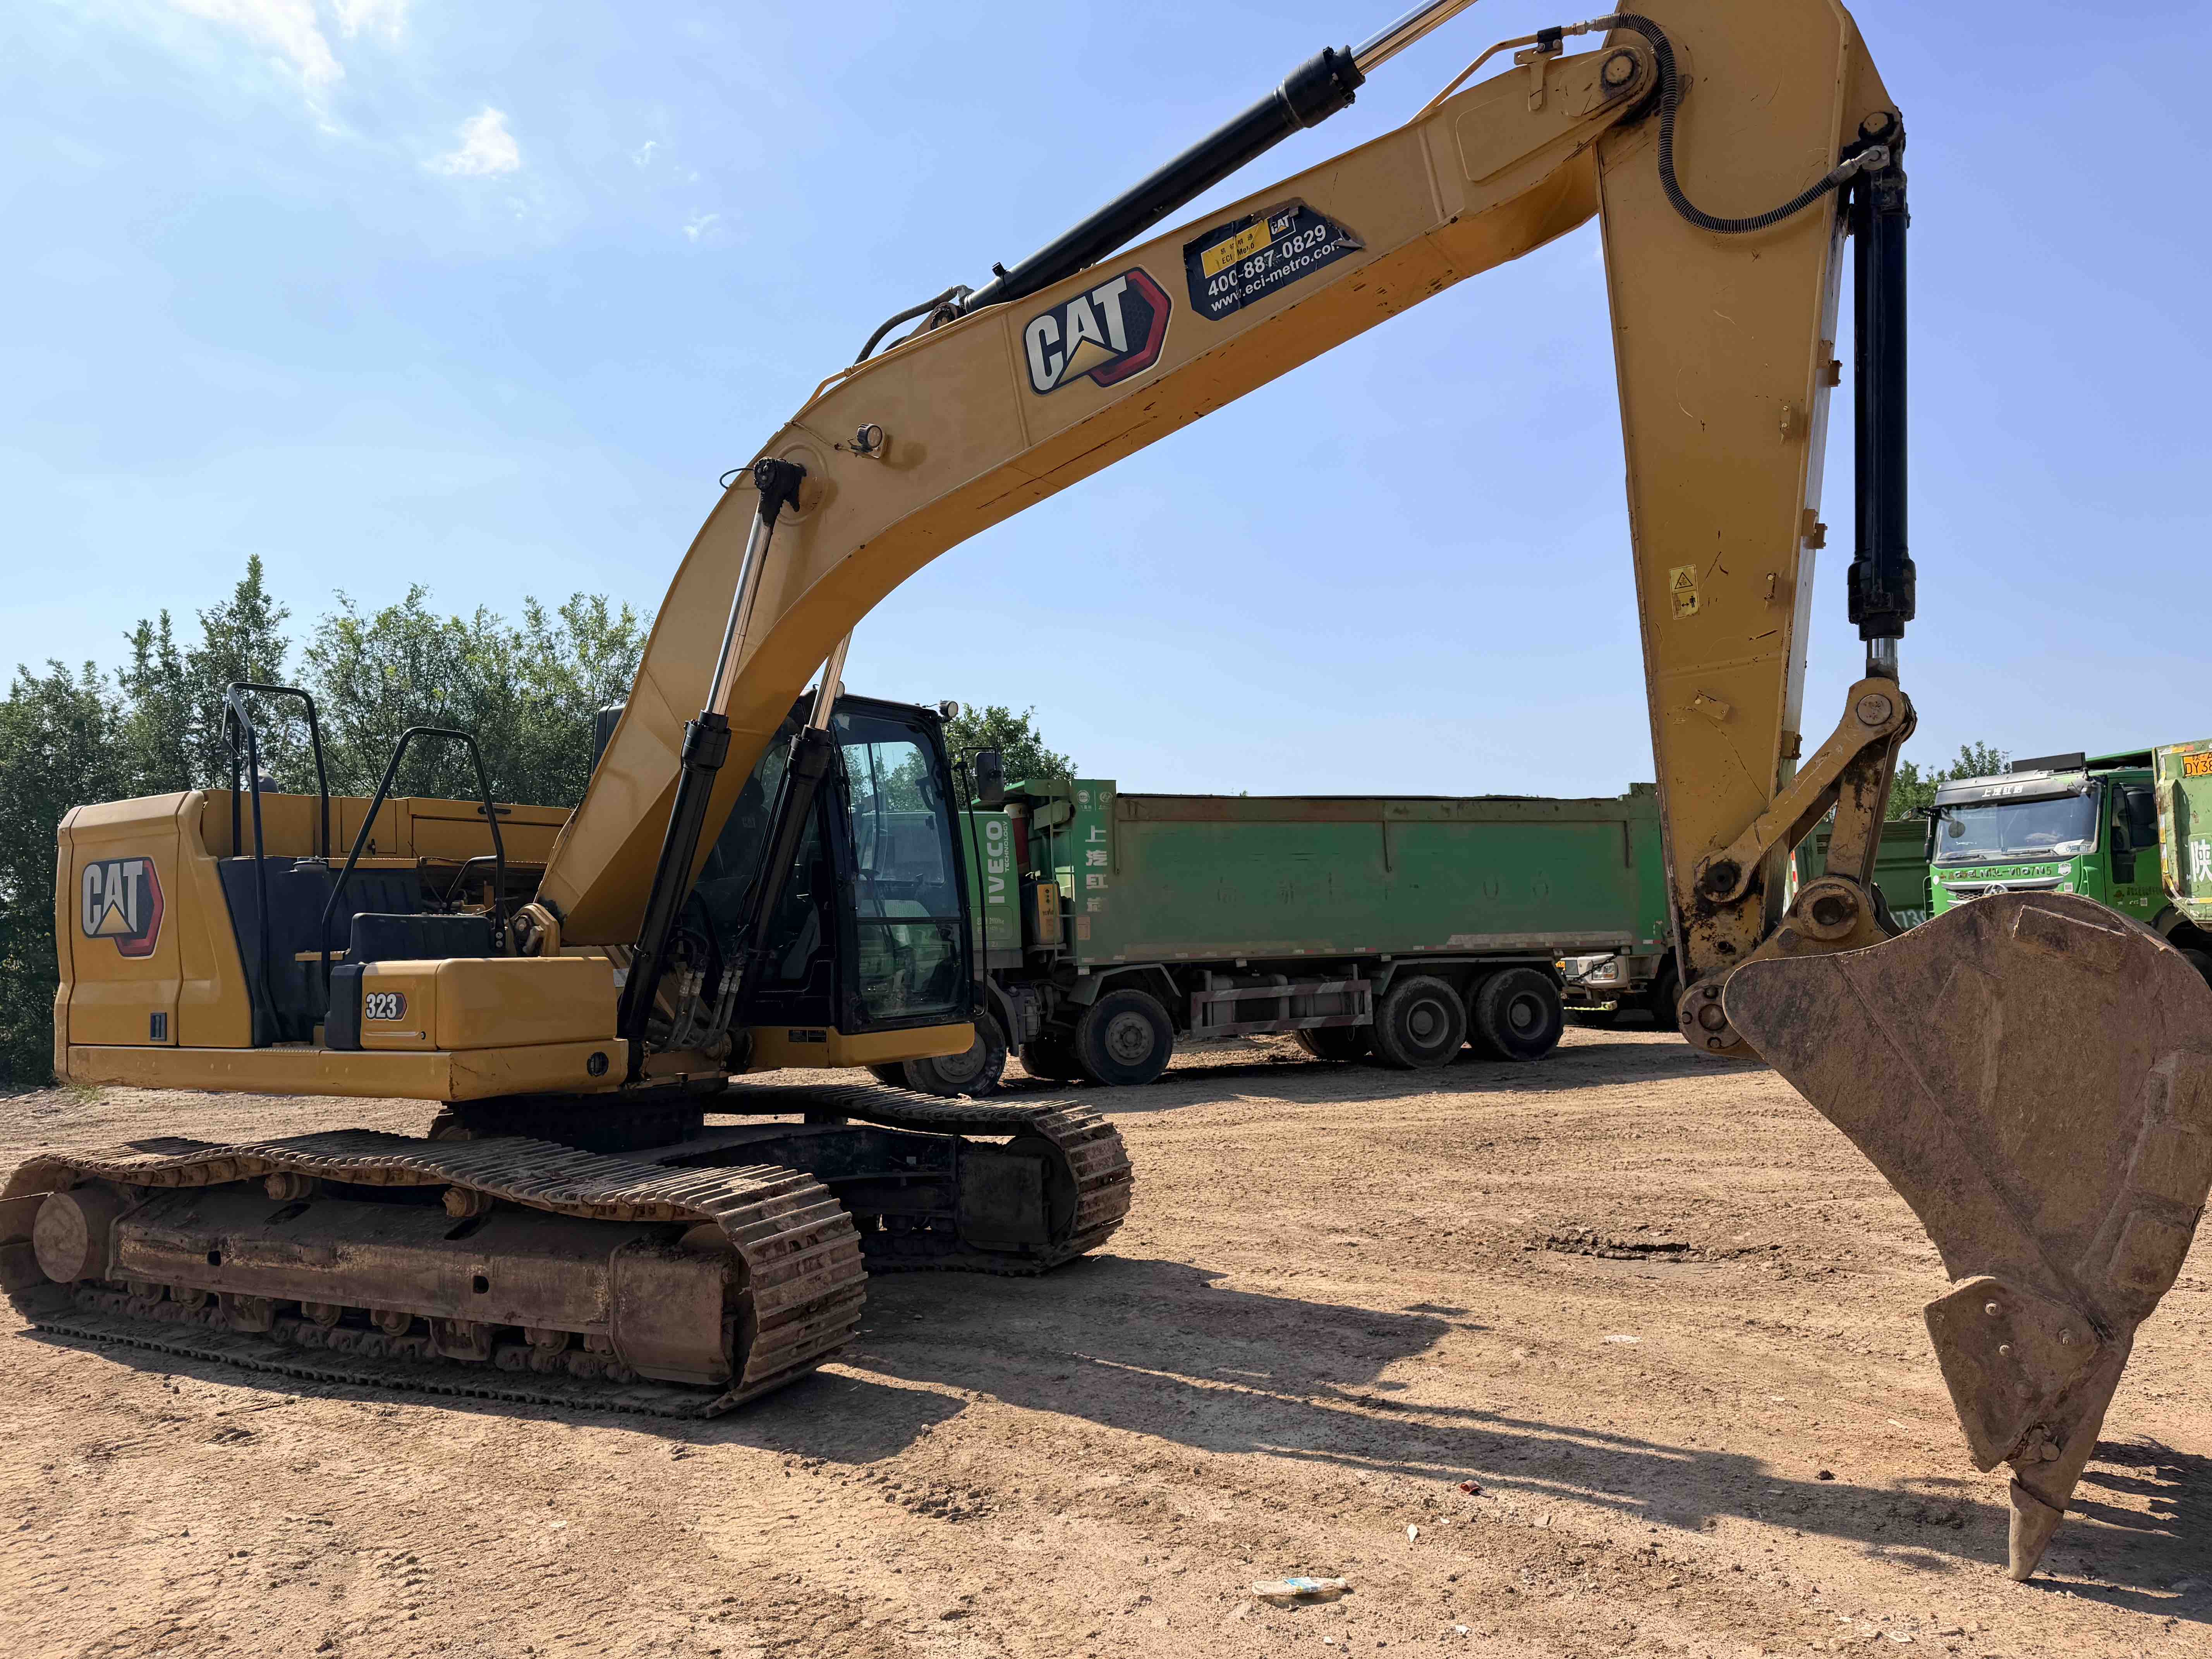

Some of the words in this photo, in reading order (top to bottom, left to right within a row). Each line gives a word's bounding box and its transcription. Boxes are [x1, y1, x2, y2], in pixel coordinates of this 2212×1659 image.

[1271, 215, 1290, 235] CAT
[1208, 225, 1326, 297] 400-887-0829
[1222, 254, 1233, 264] ECI
[1025, 276, 1128, 391] CAT
[986, 821, 1005, 903] IVECO
[2190, 839, 2212, 883] 陕
[82, 860, 143, 934] CAT
[366, 993, 397, 1018] 323
